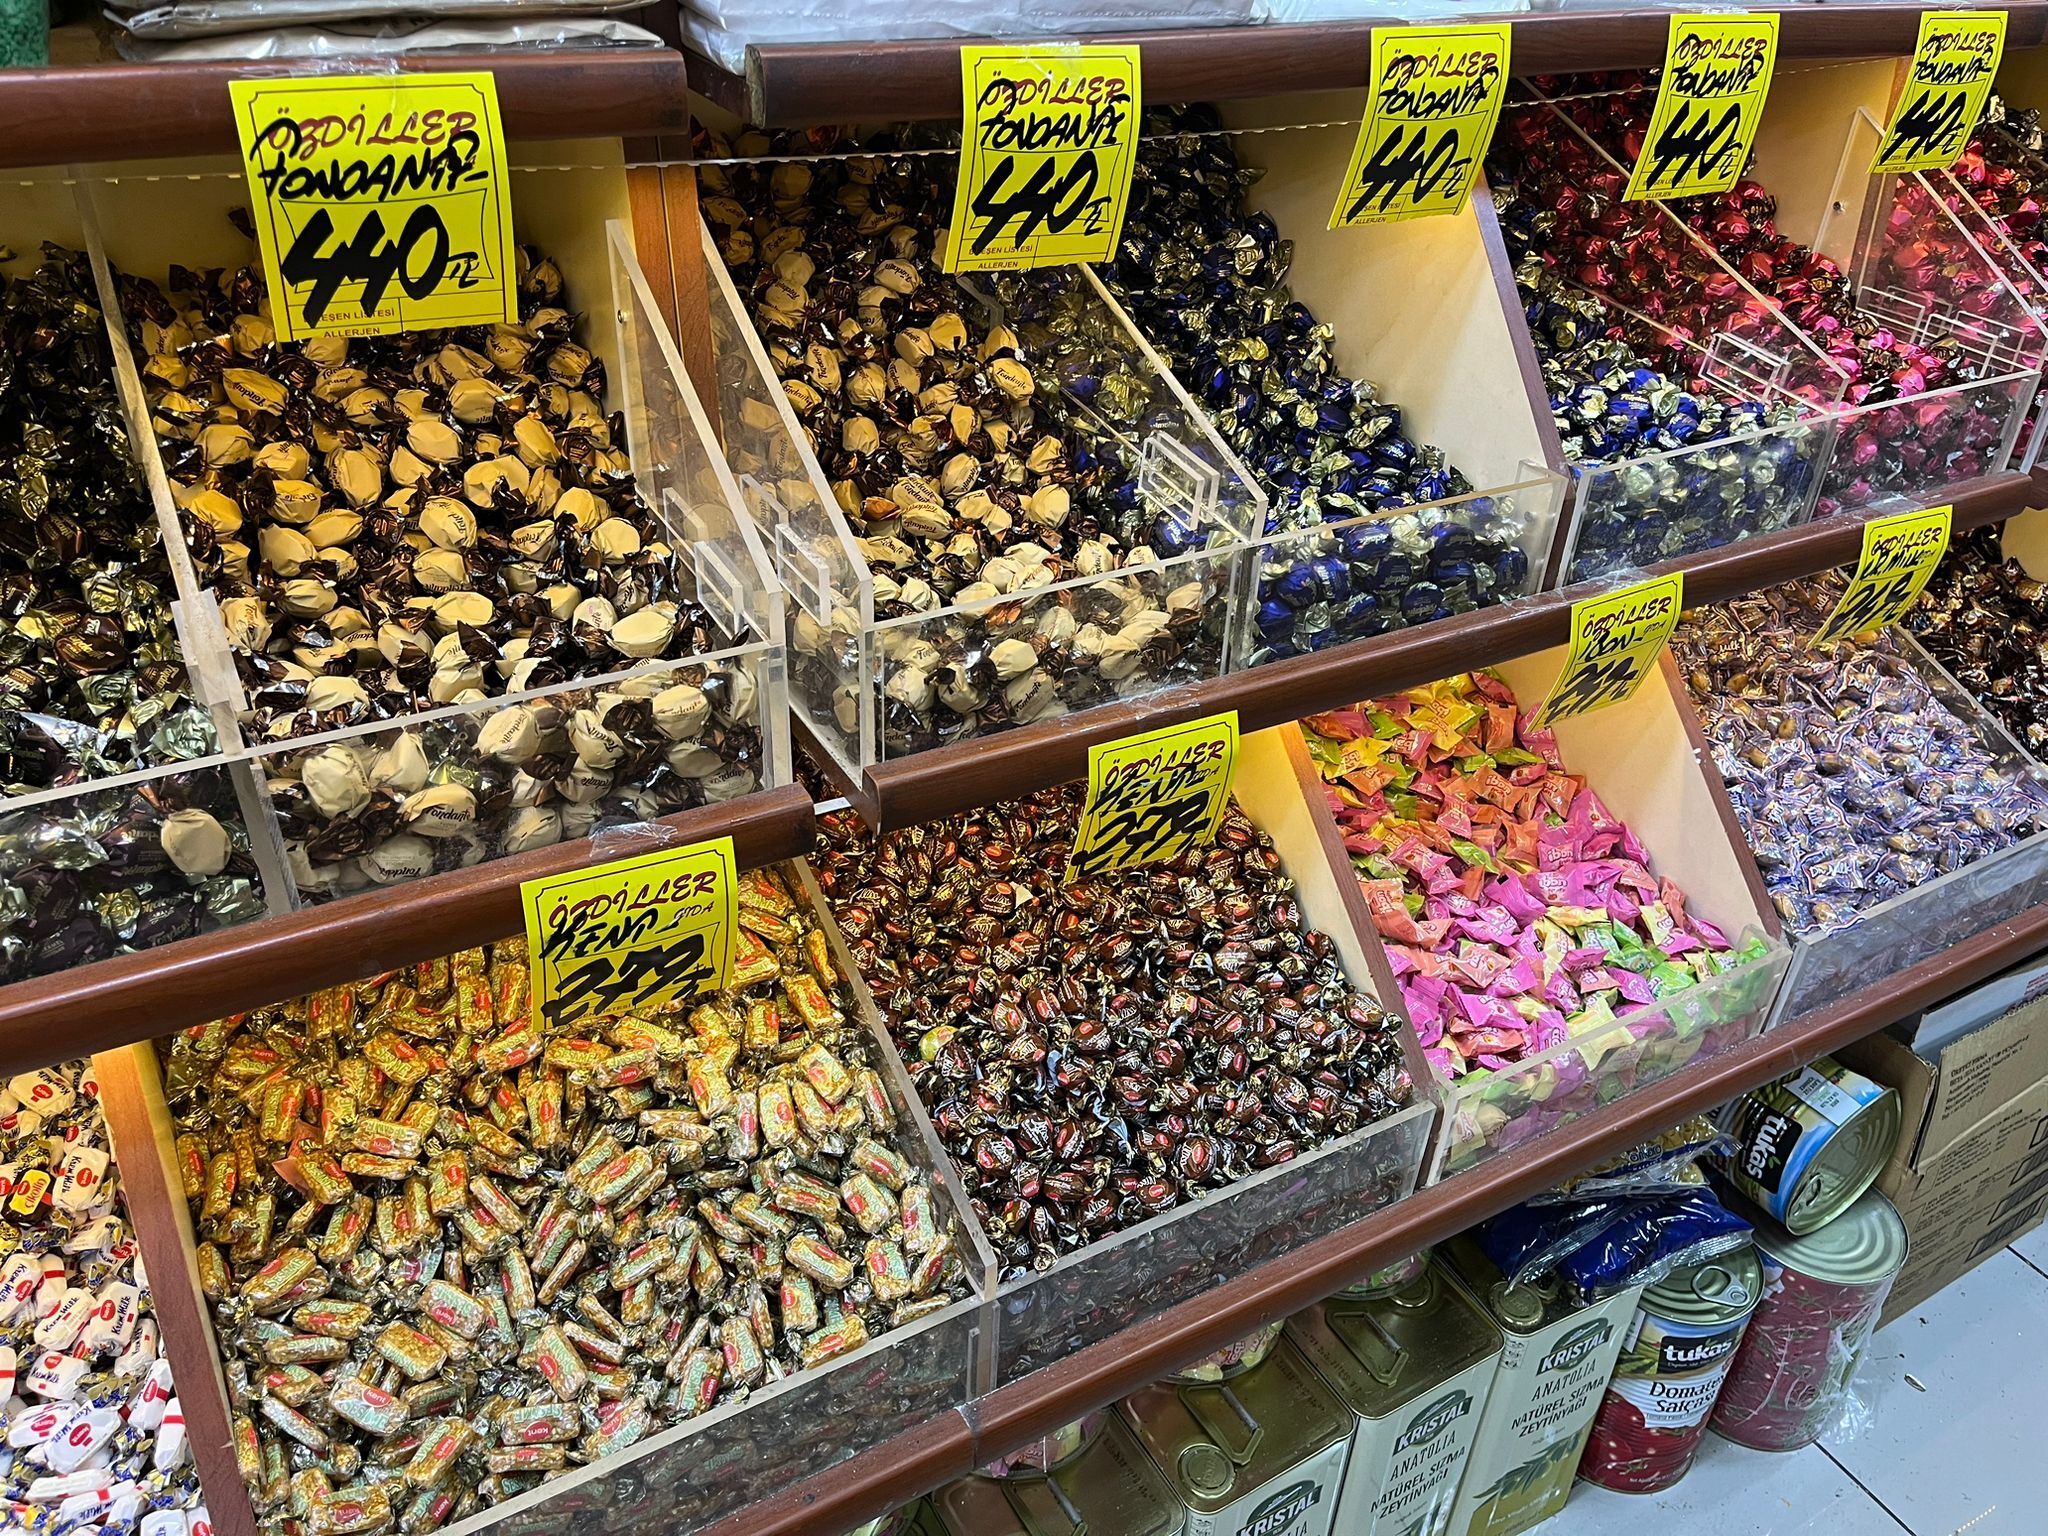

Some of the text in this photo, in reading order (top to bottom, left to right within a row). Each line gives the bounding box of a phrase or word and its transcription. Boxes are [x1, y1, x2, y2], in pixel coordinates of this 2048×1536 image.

[977, 261, 1019, 270] ALLERJEN
[324, 327, 381, 338] ALLERJEN
[1105, 739, 1226, 786] ÖZDİLLER
[548, 870, 718, 931] ÖZDİLLER
[264, 1257, 306, 1289] SESAME
[1541, 1329, 1606, 1373] KRISTAL
[680, 1360, 707, 1411] SESAME
[1511, 1375, 1605, 1430] NATÜREL SIZMA
[1531, 1358, 1597, 1402] ANATOLIA
[342, 1401, 389, 1429] SESAME
[514, 1403, 564, 1422] SESAME
[1397, 1400, 1465, 1452] KRISTAL
[1518, 1396, 1588, 1439] ZEYTİNYAĞI
[1389, 1429, 1456, 1482] ANATOLIA
[1370, 1471, 1426, 1513] NATÜREL
[1428, 1445, 1466, 1477] SIZMA
[1379, 1468, 1449, 1520] ZEYTİNYAĞI
[1240, 1491, 1316, 1536] KRISTAL
